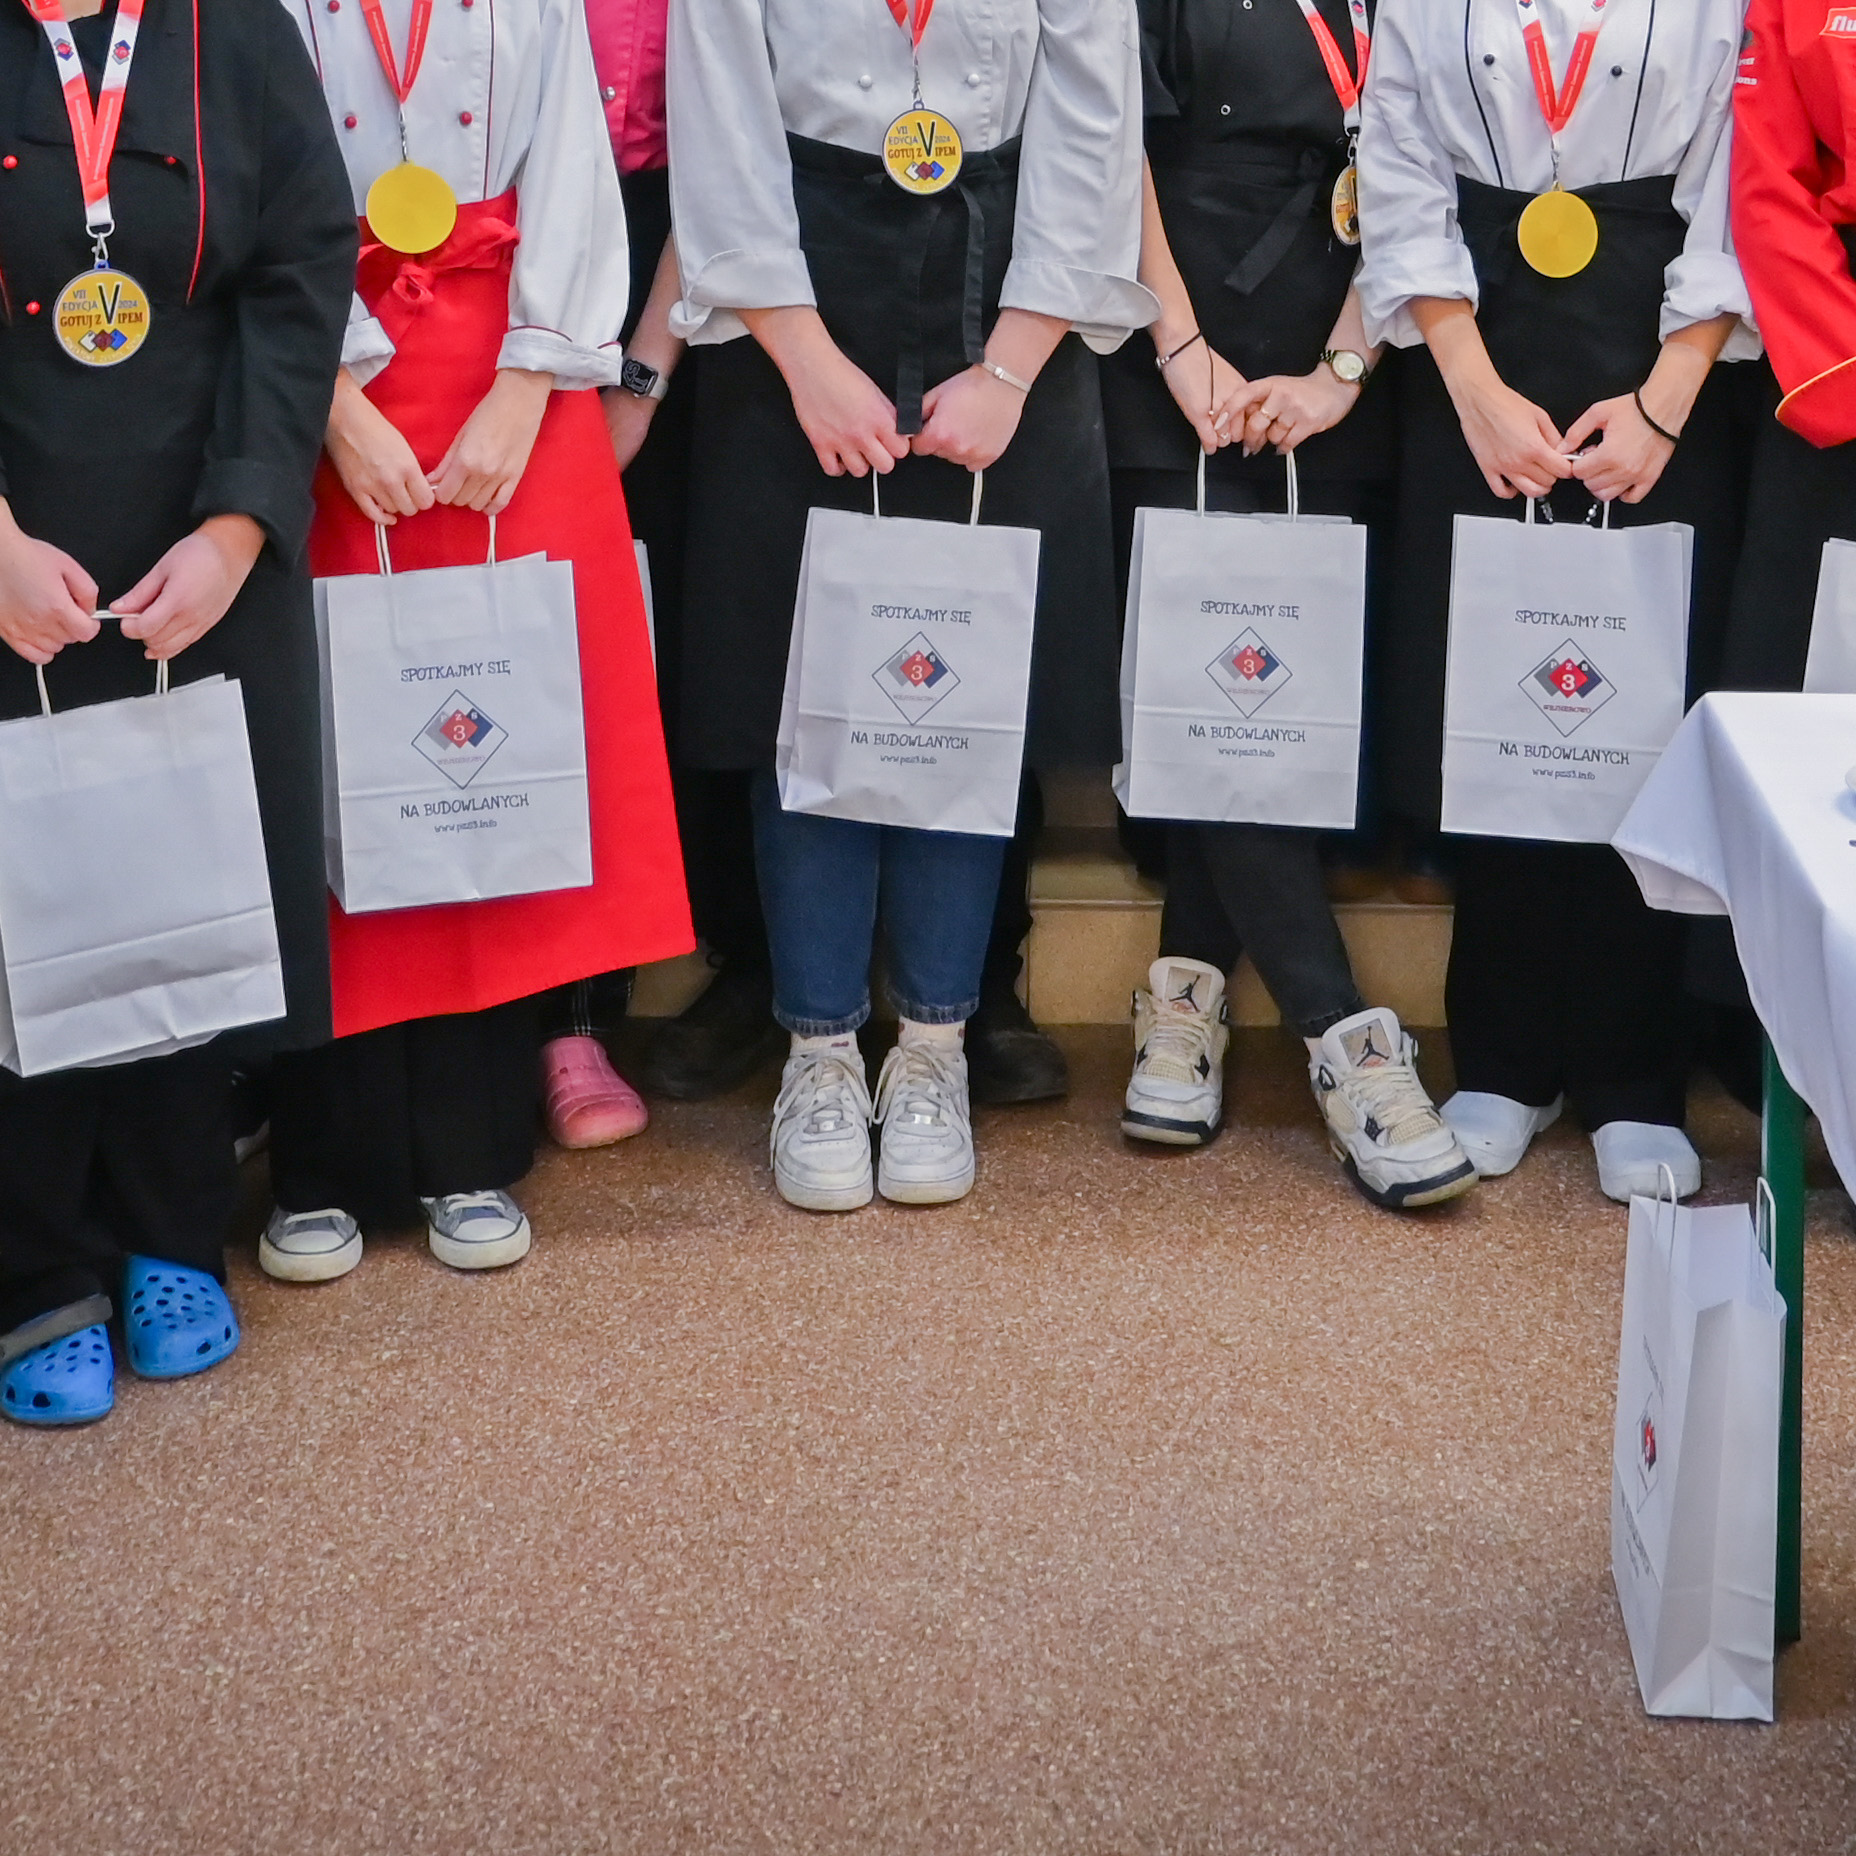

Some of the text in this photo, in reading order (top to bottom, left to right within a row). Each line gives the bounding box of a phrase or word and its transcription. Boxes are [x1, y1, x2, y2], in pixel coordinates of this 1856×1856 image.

[888, 136, 919, 146] EDYCJA
[887, 148, 915, 159] GOTUJ
[917, 147, 922, 157] Z
[62, 300, 99, 312] EDYCJA
[59, 314, 93, 328] GOTUJ
[95, 314, 102, 324] Z
[871, 604, 972, 626] SPOTKAJMY SIĘ
[1200, 600, 1299, 620] SPOTKAJMY SIĘ
[1514, 609, 1627, 632] SPOTKAJMY SIĘ
[400, 659, 511, 682] SPOTKAJMY SIĘ
[910, 665, 923, 681] 3
[1243, 659, 1255, 673] 3
[1565, 662, 1572, 670] Z
[1561, 673, 1576, 691] 3
[452, 723, 466, 742] 3
[850, 731, 969, 750] NA BUDOWLANYCH
[1188, 724, 1306, 742] NA BUDOWLANYCH
[1498, 742, 1631, 765] NA BUDOWLANYCH
[400, 793, 530, 819] NA BUDOWLANYCH
